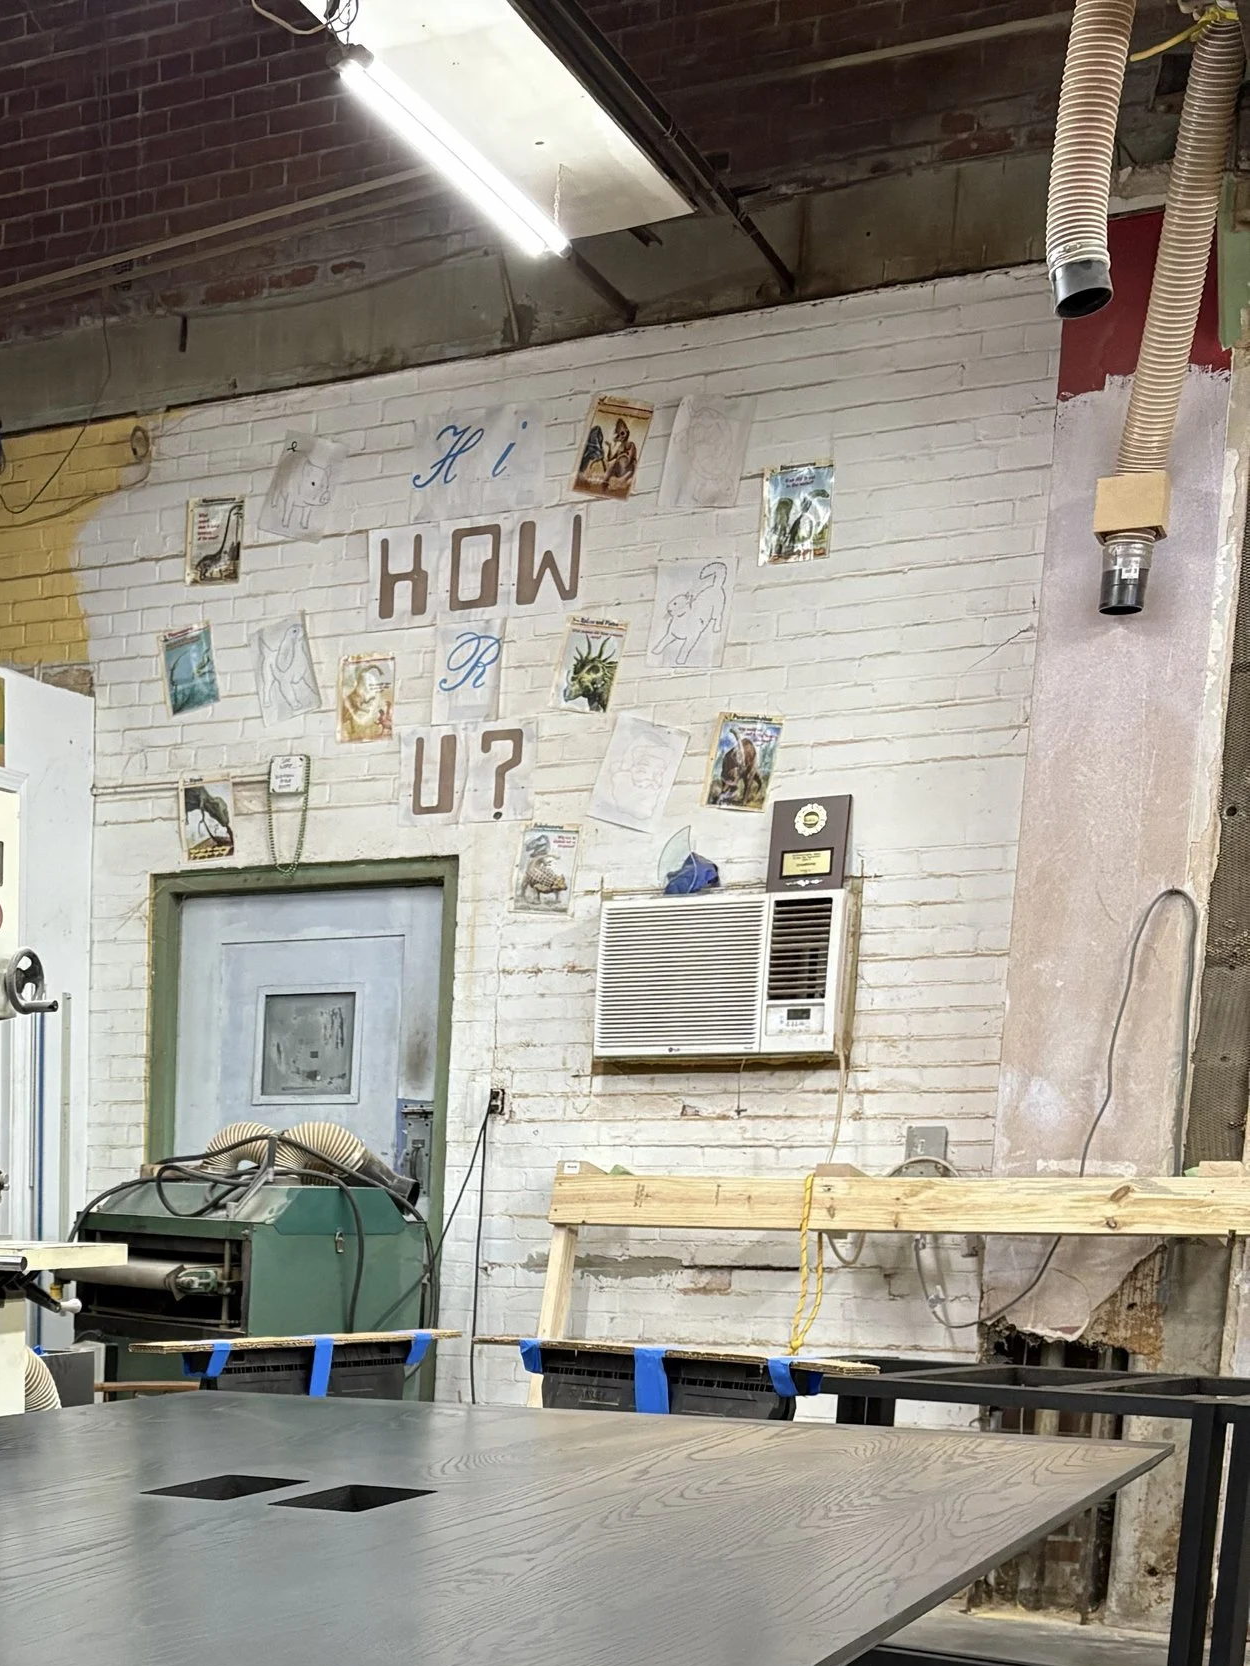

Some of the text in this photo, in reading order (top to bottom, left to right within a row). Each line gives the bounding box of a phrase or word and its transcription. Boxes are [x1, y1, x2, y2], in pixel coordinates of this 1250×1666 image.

[412, 420, 528, 489] Hi
[378, 514, 582, 620] HOW
[438, 631, 503, 692] R
